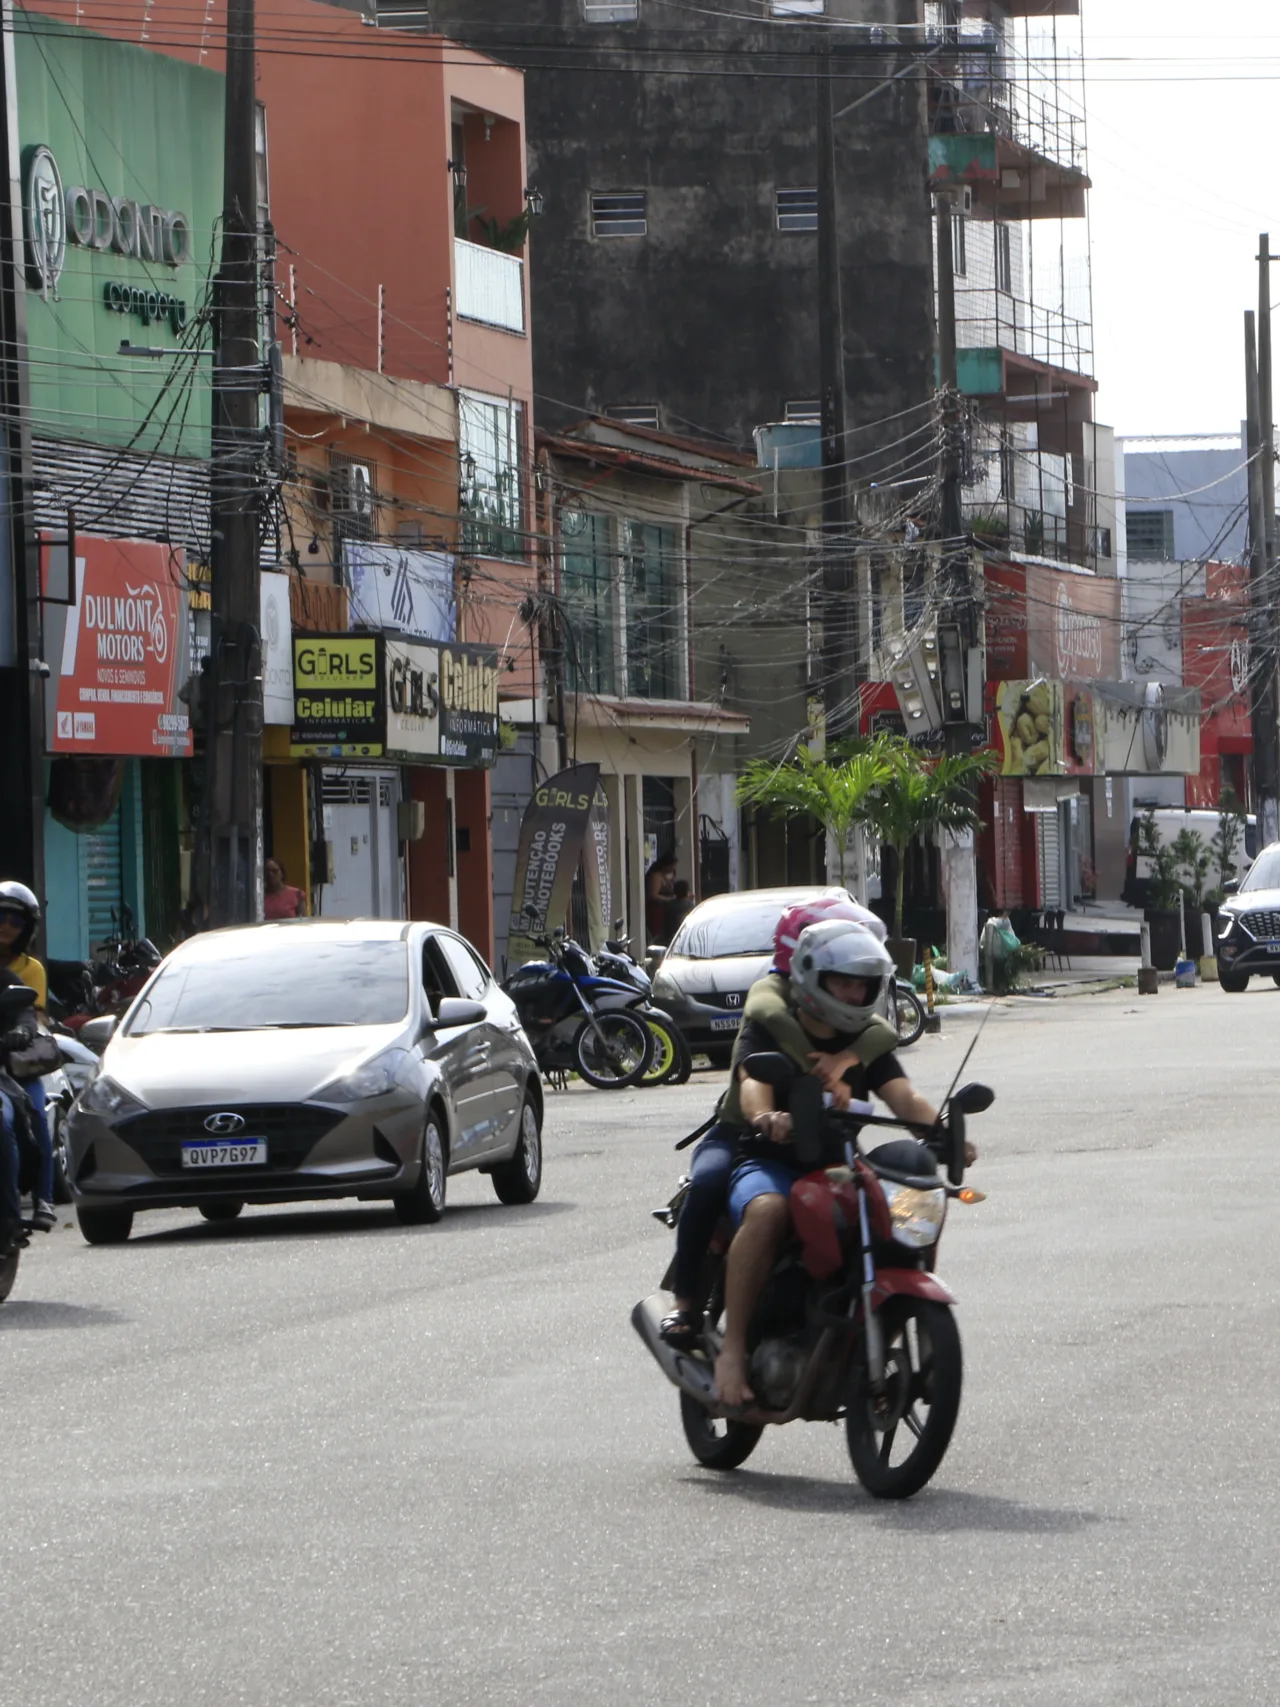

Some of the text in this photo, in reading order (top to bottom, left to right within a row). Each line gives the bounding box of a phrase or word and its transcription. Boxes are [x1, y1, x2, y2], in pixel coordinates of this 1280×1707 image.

[66, 186, 188, 266] ODONTO
[85, 595, 152, 632] DULMONT
[97, 633, 144, 662] MOTORS
[97, 668, 113, 684] NOVOS
[119, 670, 146, 685] SEMINOVOS
[441, 649, 498, 716] Celular
[297, 697, 375, 718] Celular
[537, 822, 567, 915] NOTEBOOKS
[190, 1146, 258, 1165] QVP7G97
